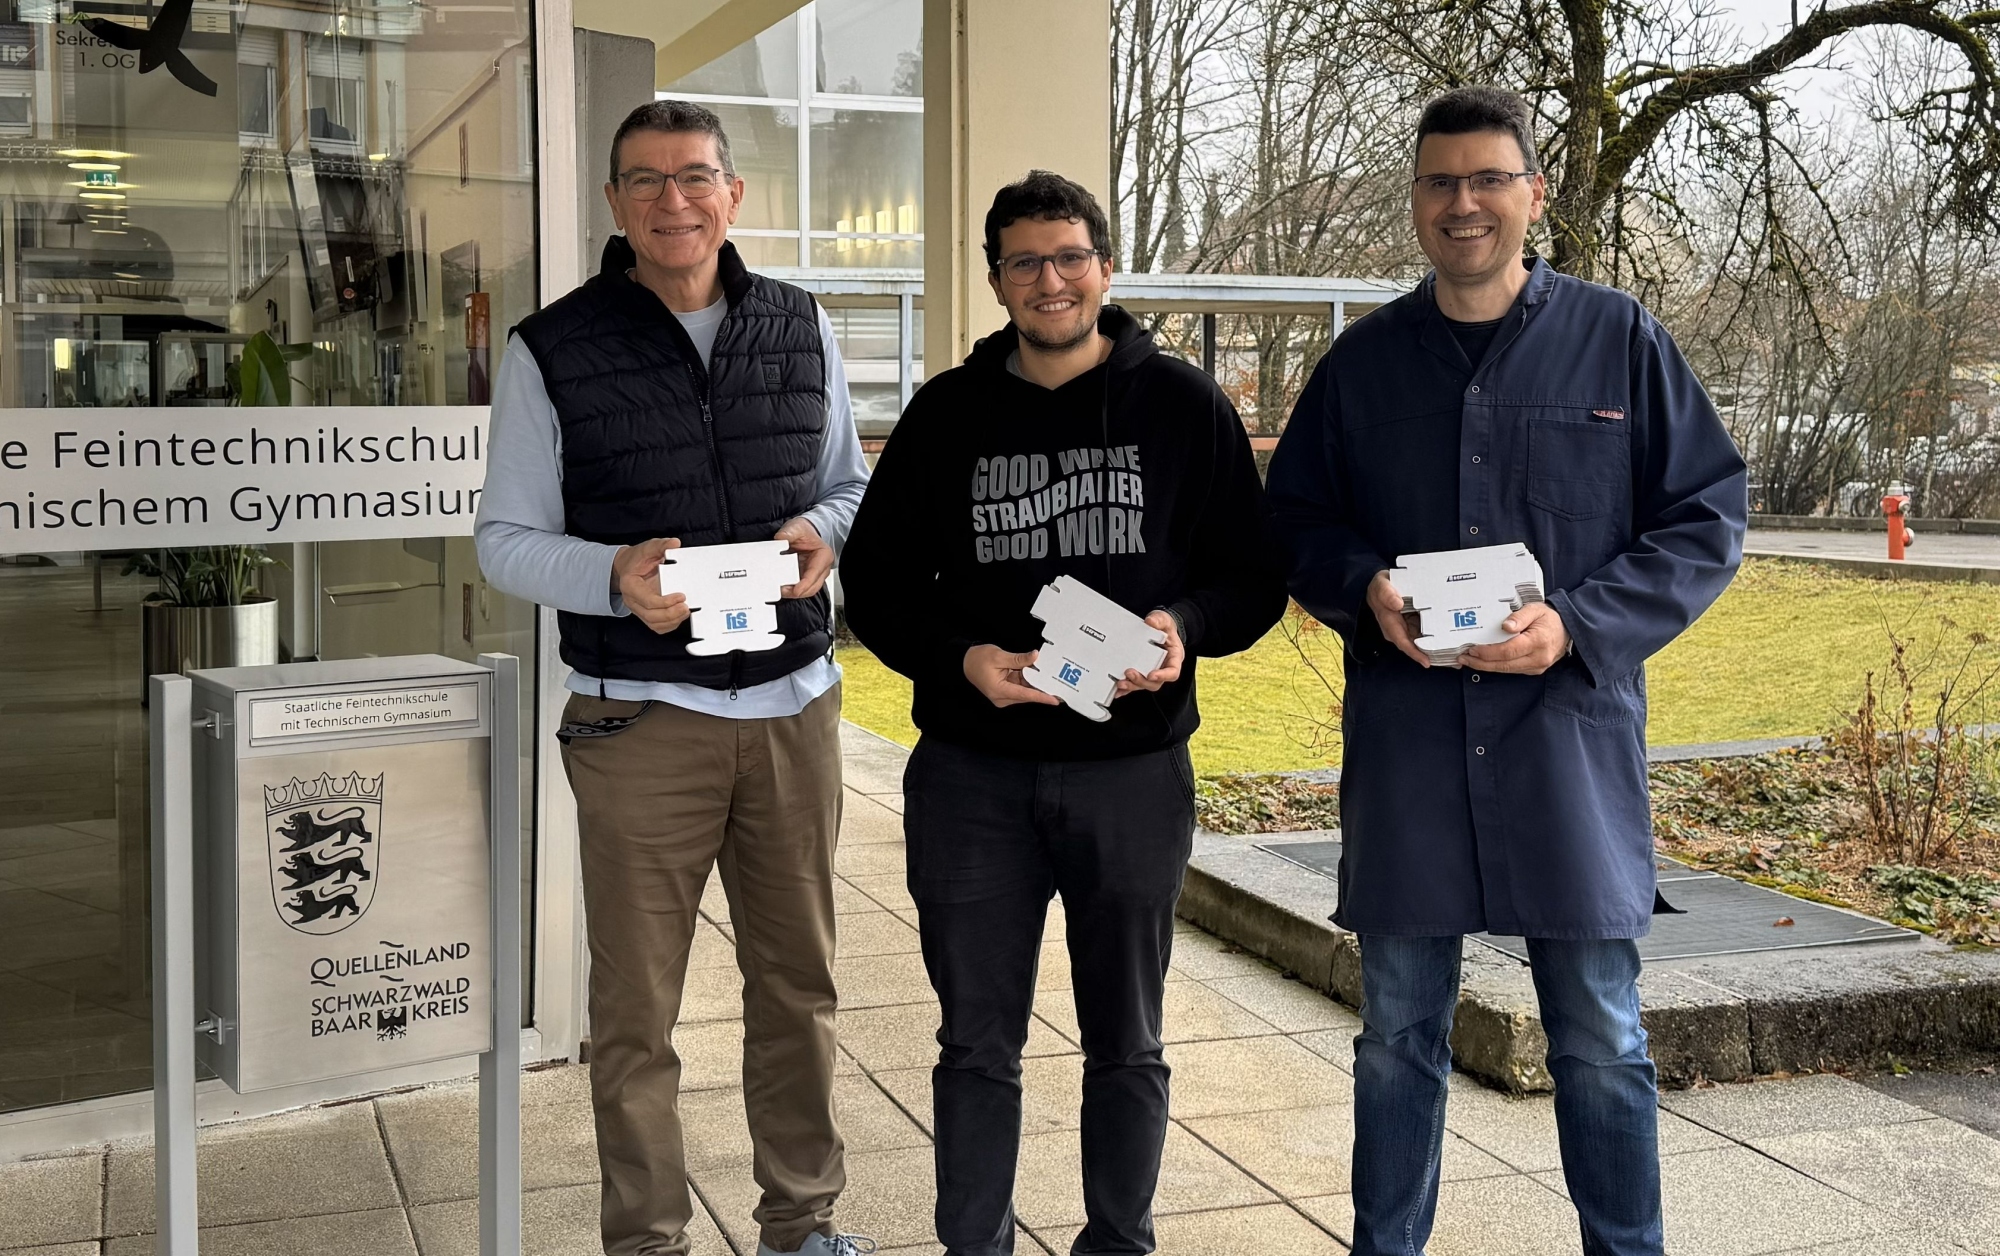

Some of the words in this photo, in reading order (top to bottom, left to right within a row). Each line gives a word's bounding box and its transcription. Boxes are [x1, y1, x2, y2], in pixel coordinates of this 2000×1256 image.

[79, 52, 94, 67] 1.
[102, 52, 135, 69] OG
[972, 454, 1049, 501] GOOD
[975, 528, 1049, 564] GOOD
[1057, 507, 1146, 557] WORK
[280, 720, 301, 731] mit
[304, 714, 380, 730] Technischem
[383, 708, 452, 724] Gymnasium
[285, 701, 343, 714] Staatliche
[346, 691, 449, 709] Feintechnikschule
[311, 942, 470, 987] QUELLENLAND
[311, 977, 470, 1016] SCHWARZWALD
[311, 1012, 372, 1037] BAAR
[411, 995, 470, 1021] KREIS
